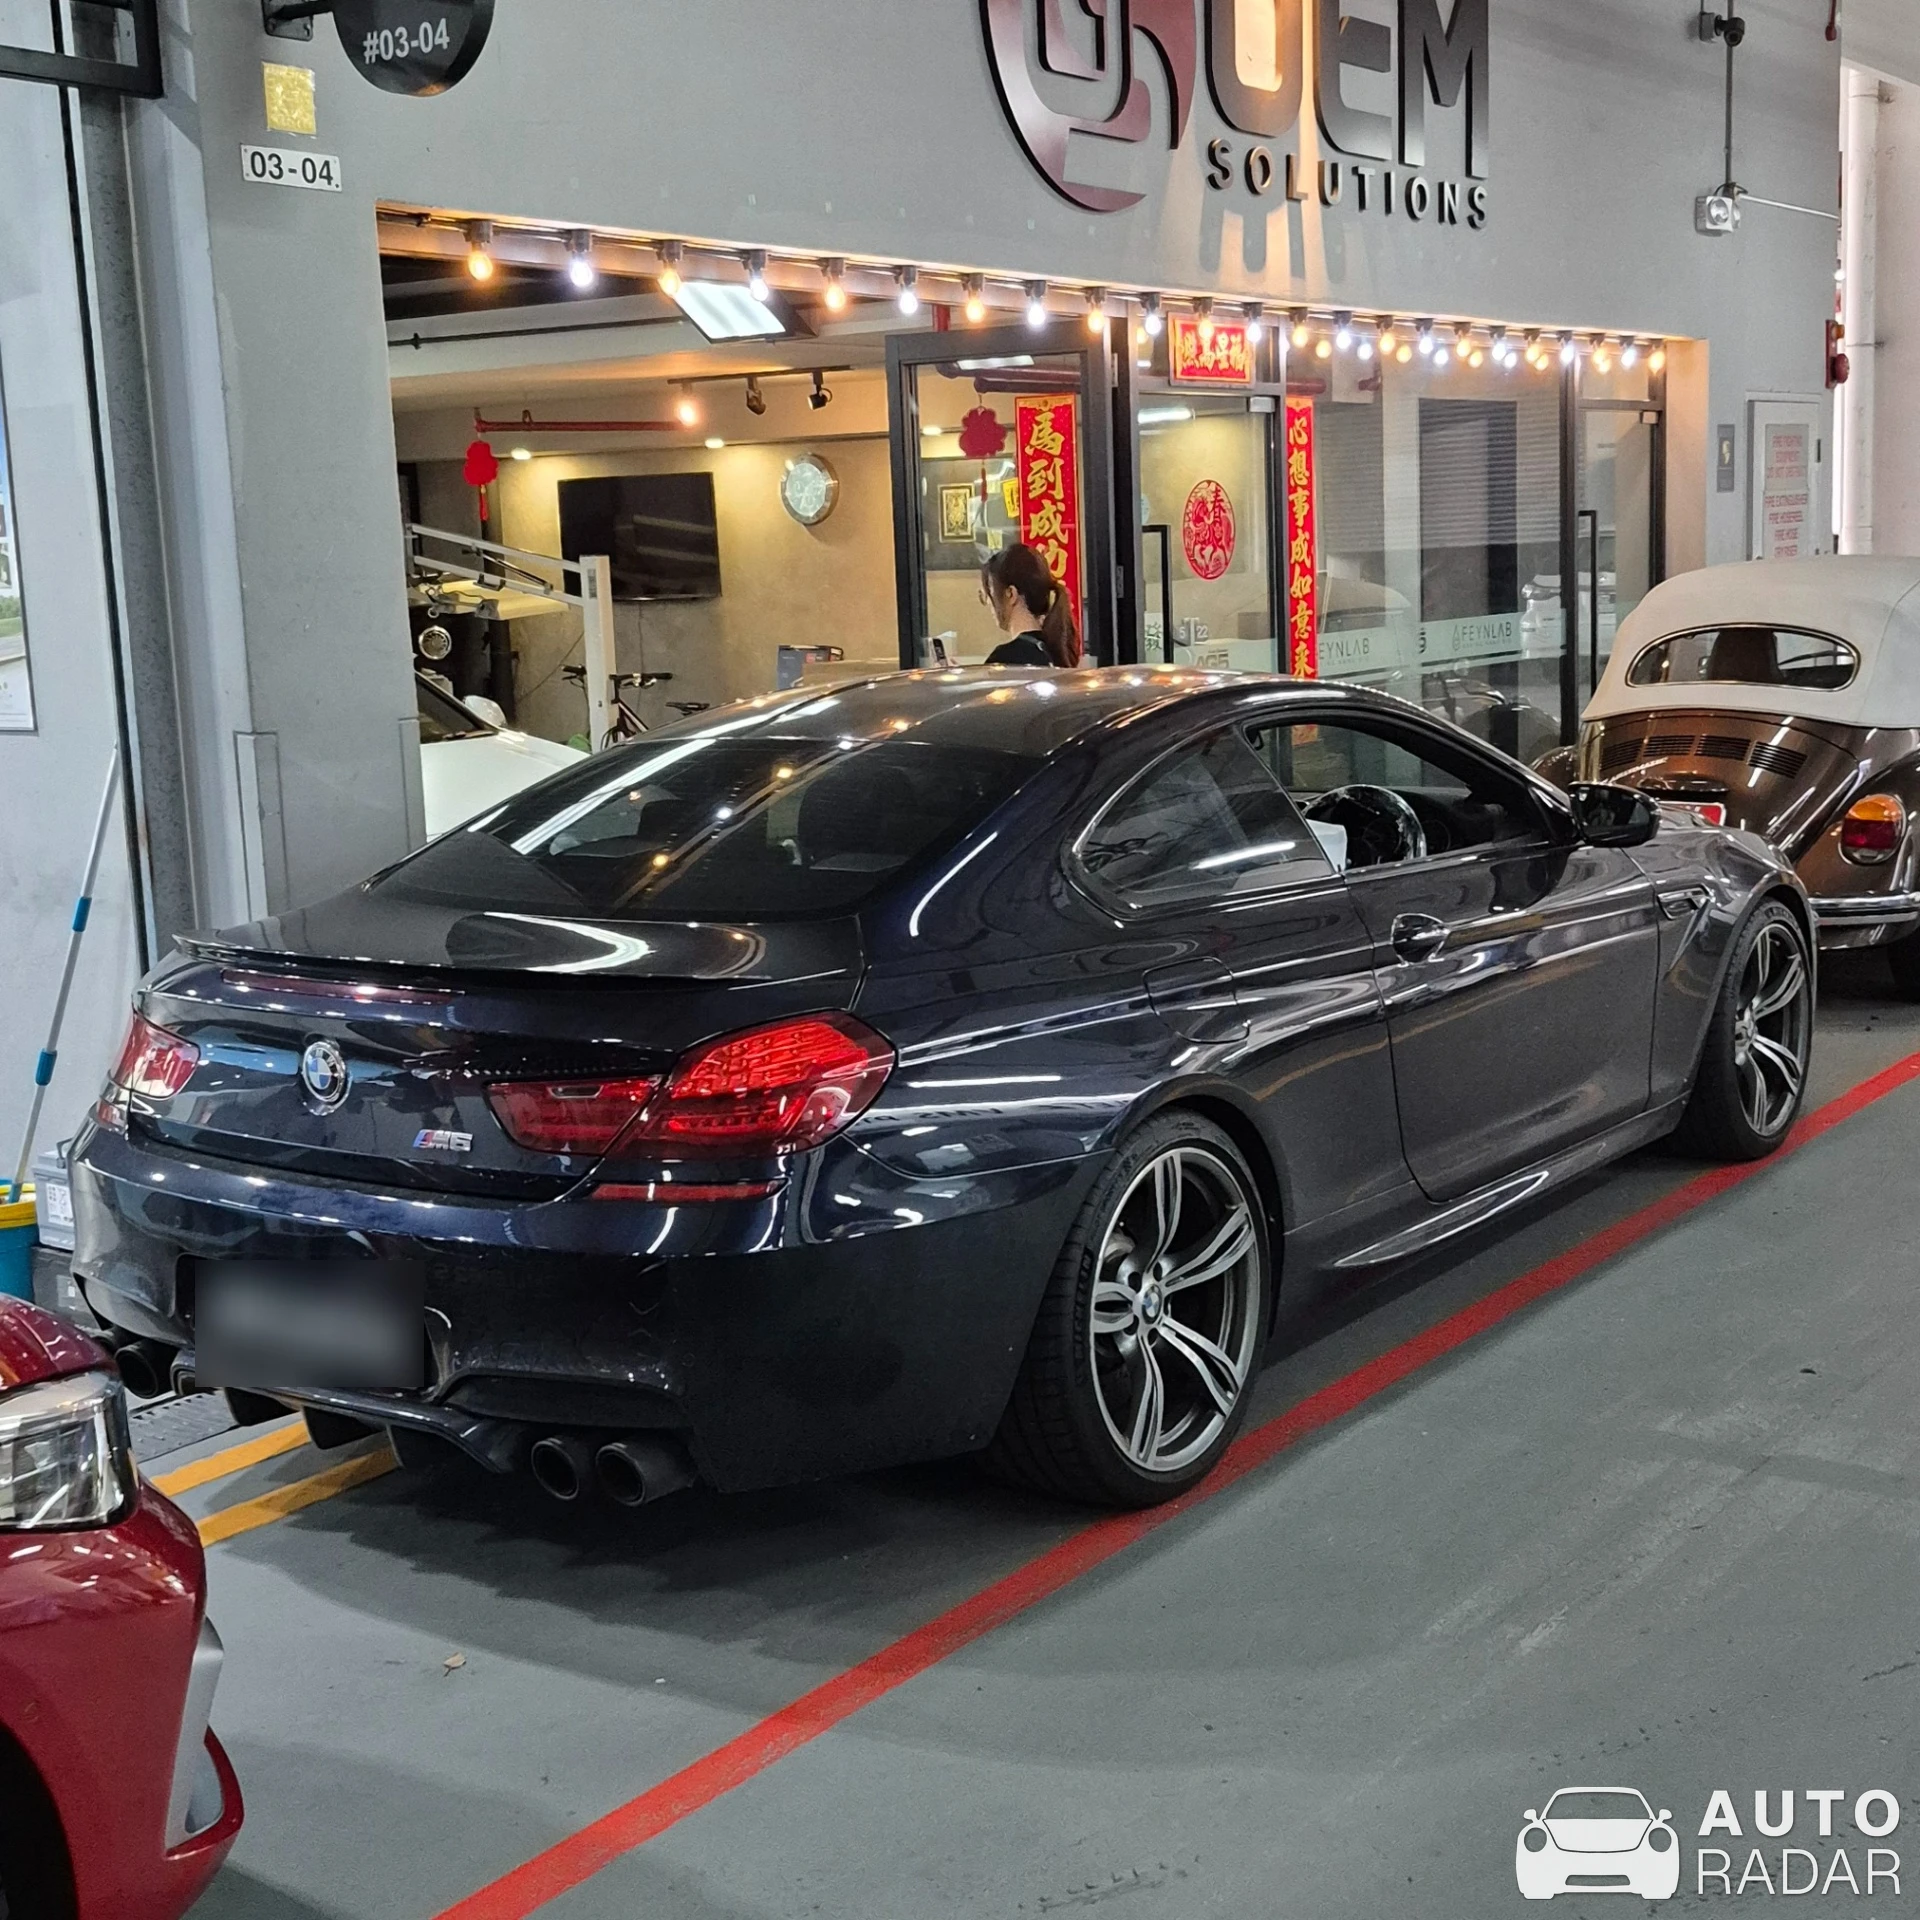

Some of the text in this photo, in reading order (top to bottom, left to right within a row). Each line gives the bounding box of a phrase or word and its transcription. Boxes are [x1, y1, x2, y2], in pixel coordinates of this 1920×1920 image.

[363, 18, 450, 64] #03-04
[250, 151, 334, 186] 03-04
[1207, 138, 1488, 230] SOLUTIONS
[1025, 411, 1069, 610] 馬到成功
[1319, 637, 1370, 660] EYNLAB
[1461, 621, 1513, 642] FEYNLAB
[414, 1129, 473, 1151] M6
